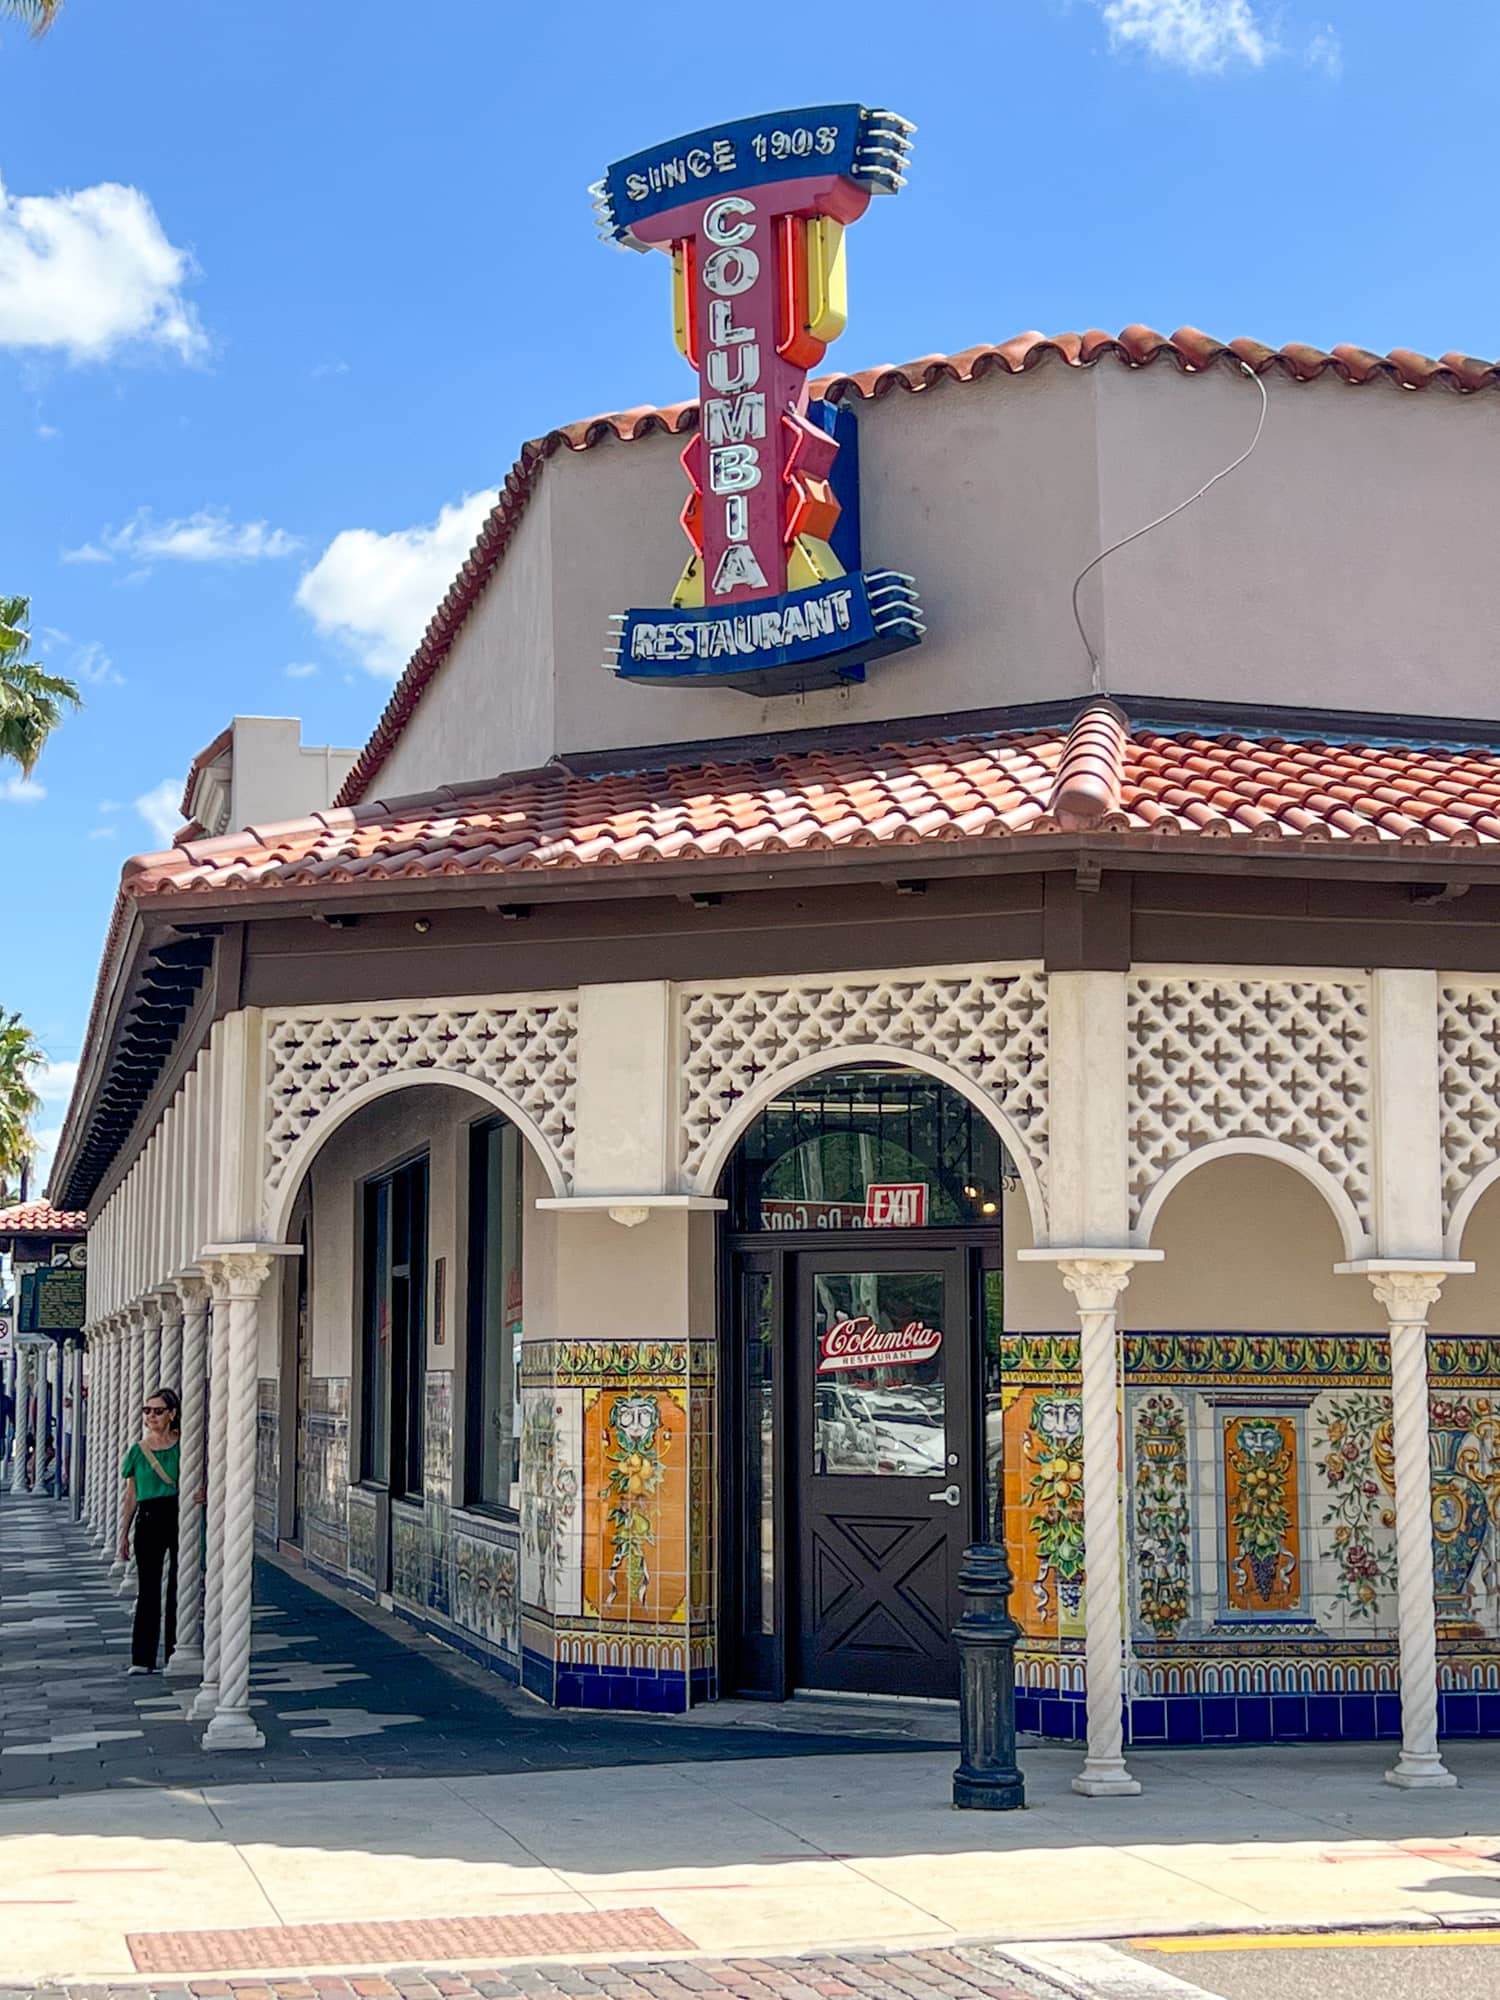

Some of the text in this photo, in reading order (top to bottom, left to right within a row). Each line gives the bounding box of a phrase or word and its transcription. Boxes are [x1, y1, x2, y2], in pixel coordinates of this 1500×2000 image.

[626, 127, 838, 200] SINCE 1905
[702, 197, 768, 595] COLUMBIA
[631, 590, 852, 660] RESTAURANT
[873, 1189, 920, 1224] EXIT
[825, 1316, 937, 1356] Columbia
[842, 1350, 914, 1364] RESTAURANT
